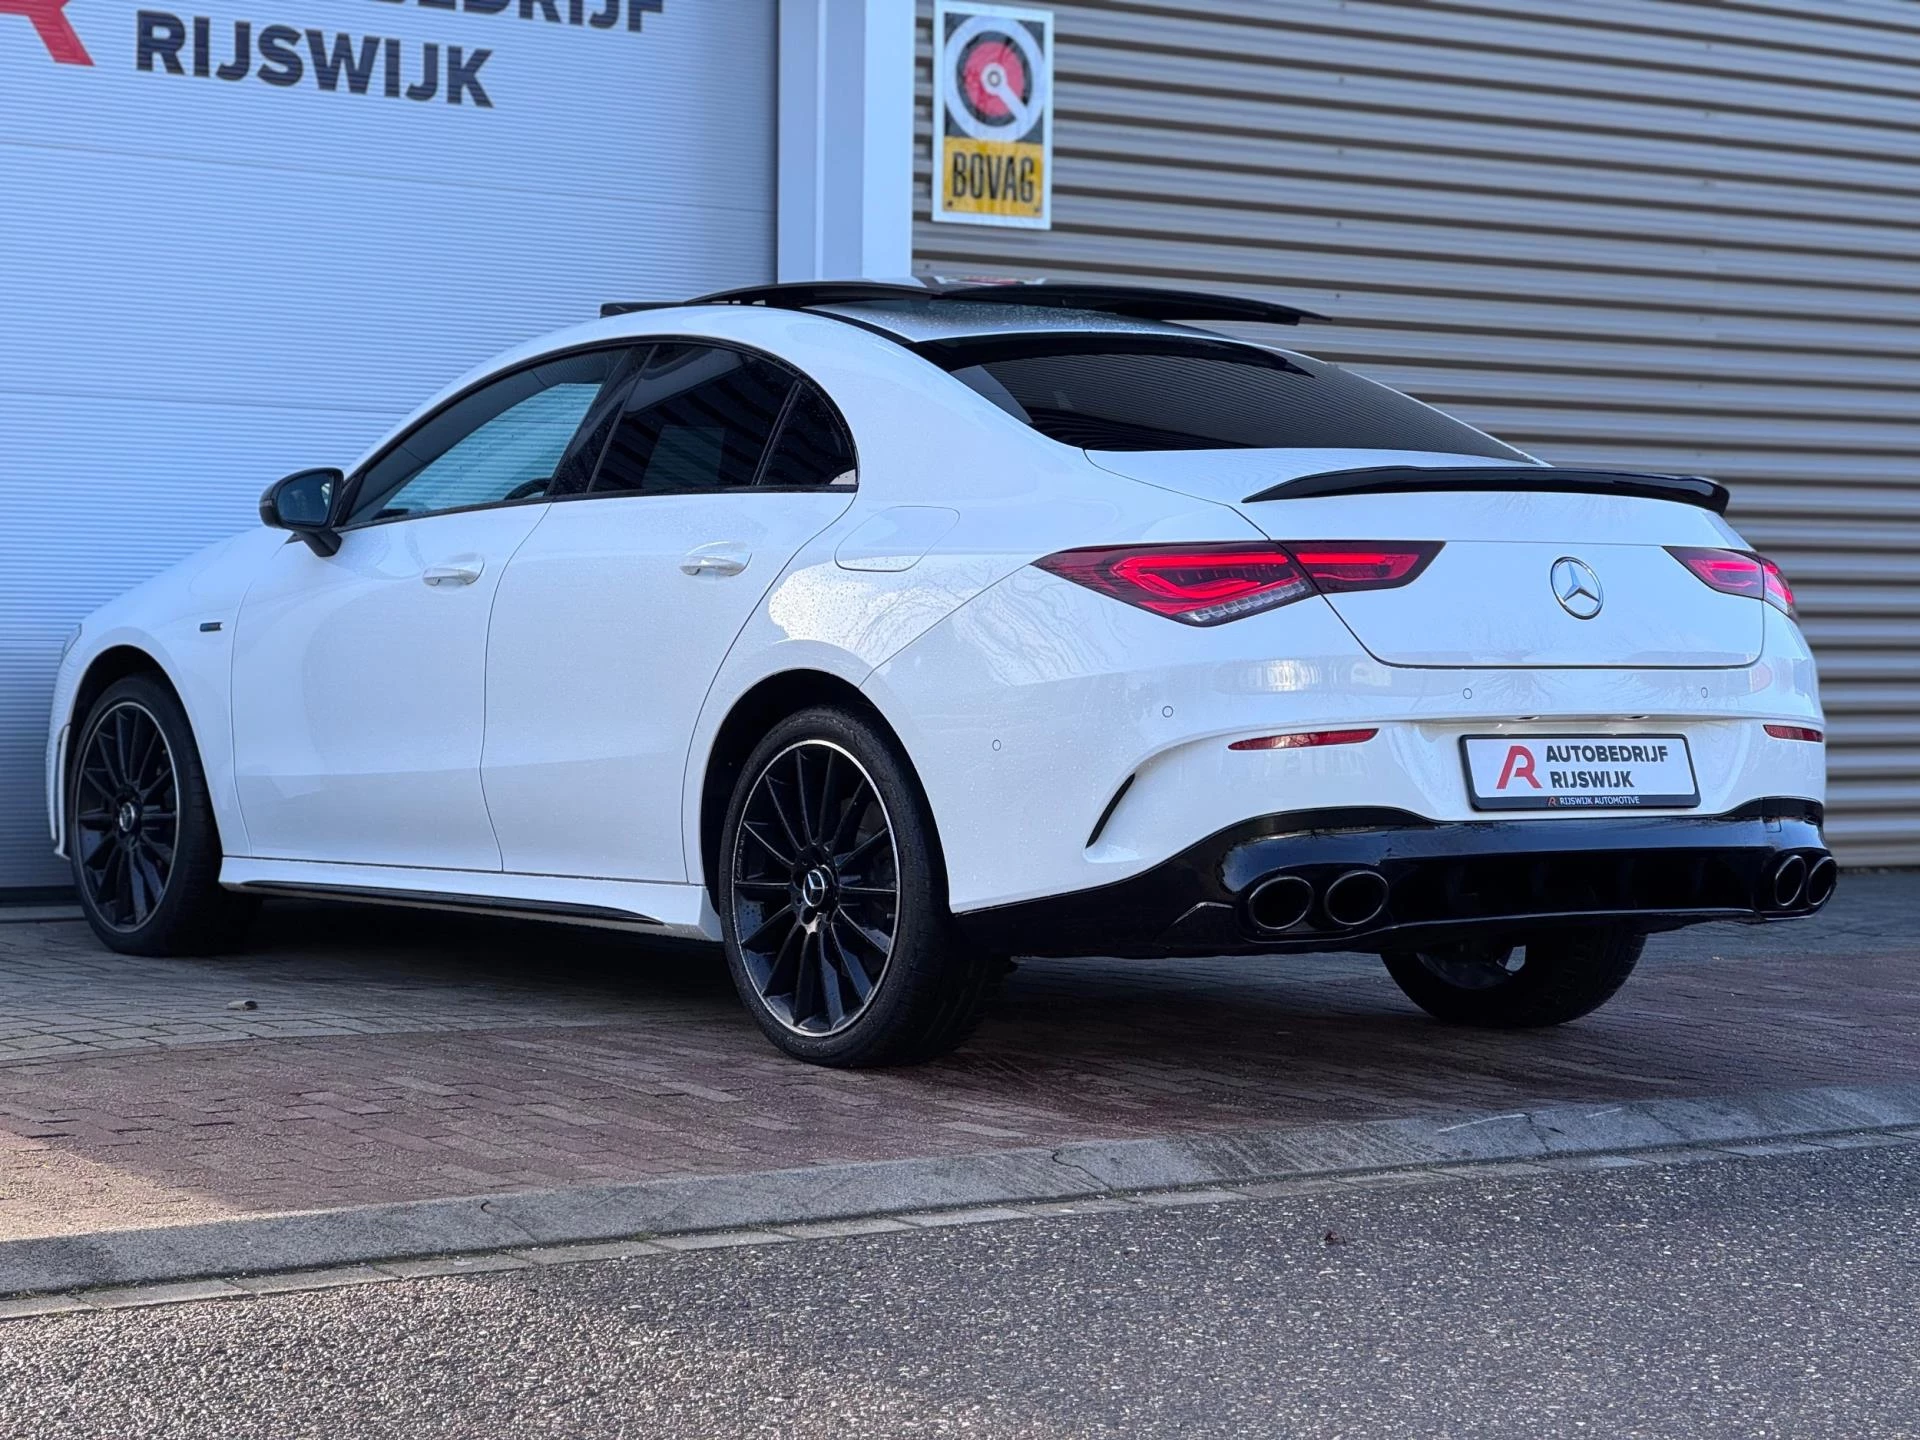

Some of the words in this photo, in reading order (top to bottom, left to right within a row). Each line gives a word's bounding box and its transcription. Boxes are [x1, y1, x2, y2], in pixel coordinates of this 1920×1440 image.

[136, 9, 494, 108] RIJSWIJK
[952, 151, 1035, 204] BOVAG
[1546, 745, 1669, 762] AUTOBEDRIJF
[1549, 771, 1635, 789] RIJSWIJK
[1559, 796, 1593, 806] RIJSWIJK
[1594, 796, 1640, 805] AUTOMOTIVE
